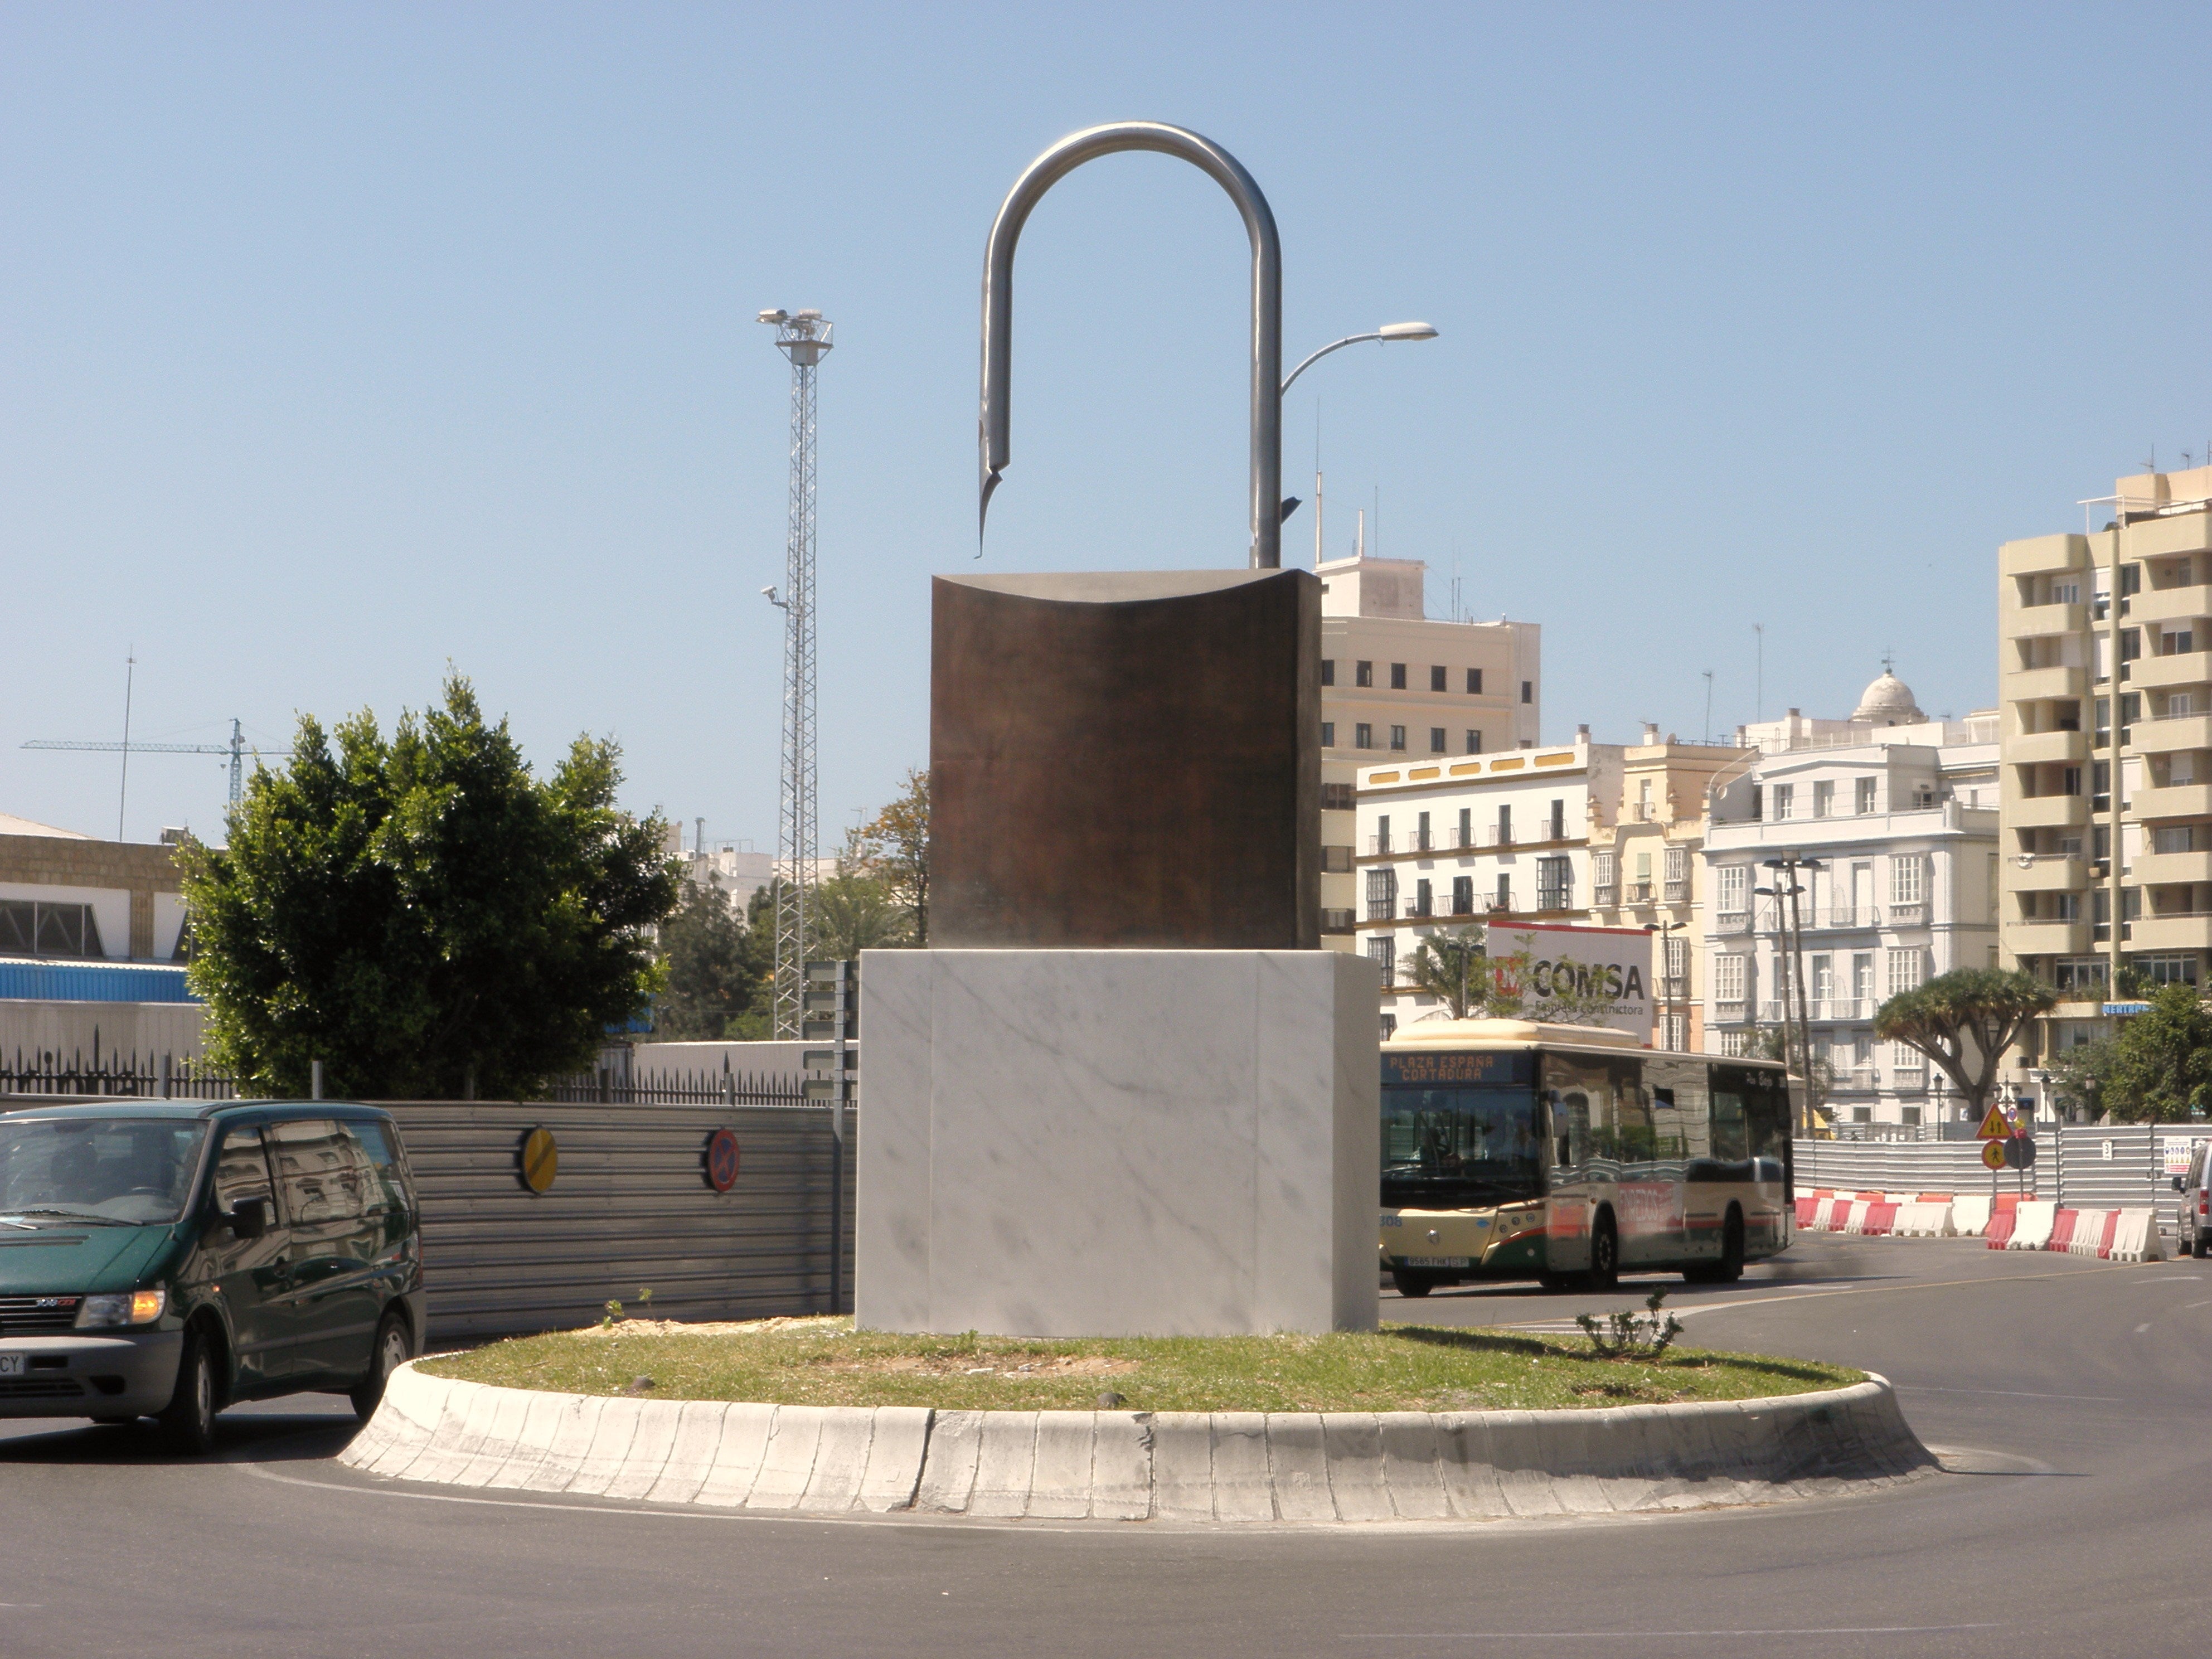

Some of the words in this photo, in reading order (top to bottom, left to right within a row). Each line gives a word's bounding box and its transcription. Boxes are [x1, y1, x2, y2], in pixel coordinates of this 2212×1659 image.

[1534, 959, 1645, 1000] COMSA
[1390, 1057, 1434, 1069] PLAZA
[1440, 1056, 1493, 1069] ESPAÑA
[1401, 1069, 1481, 1081] CORTADURA
[0, 1356, 19, 1373] CY
